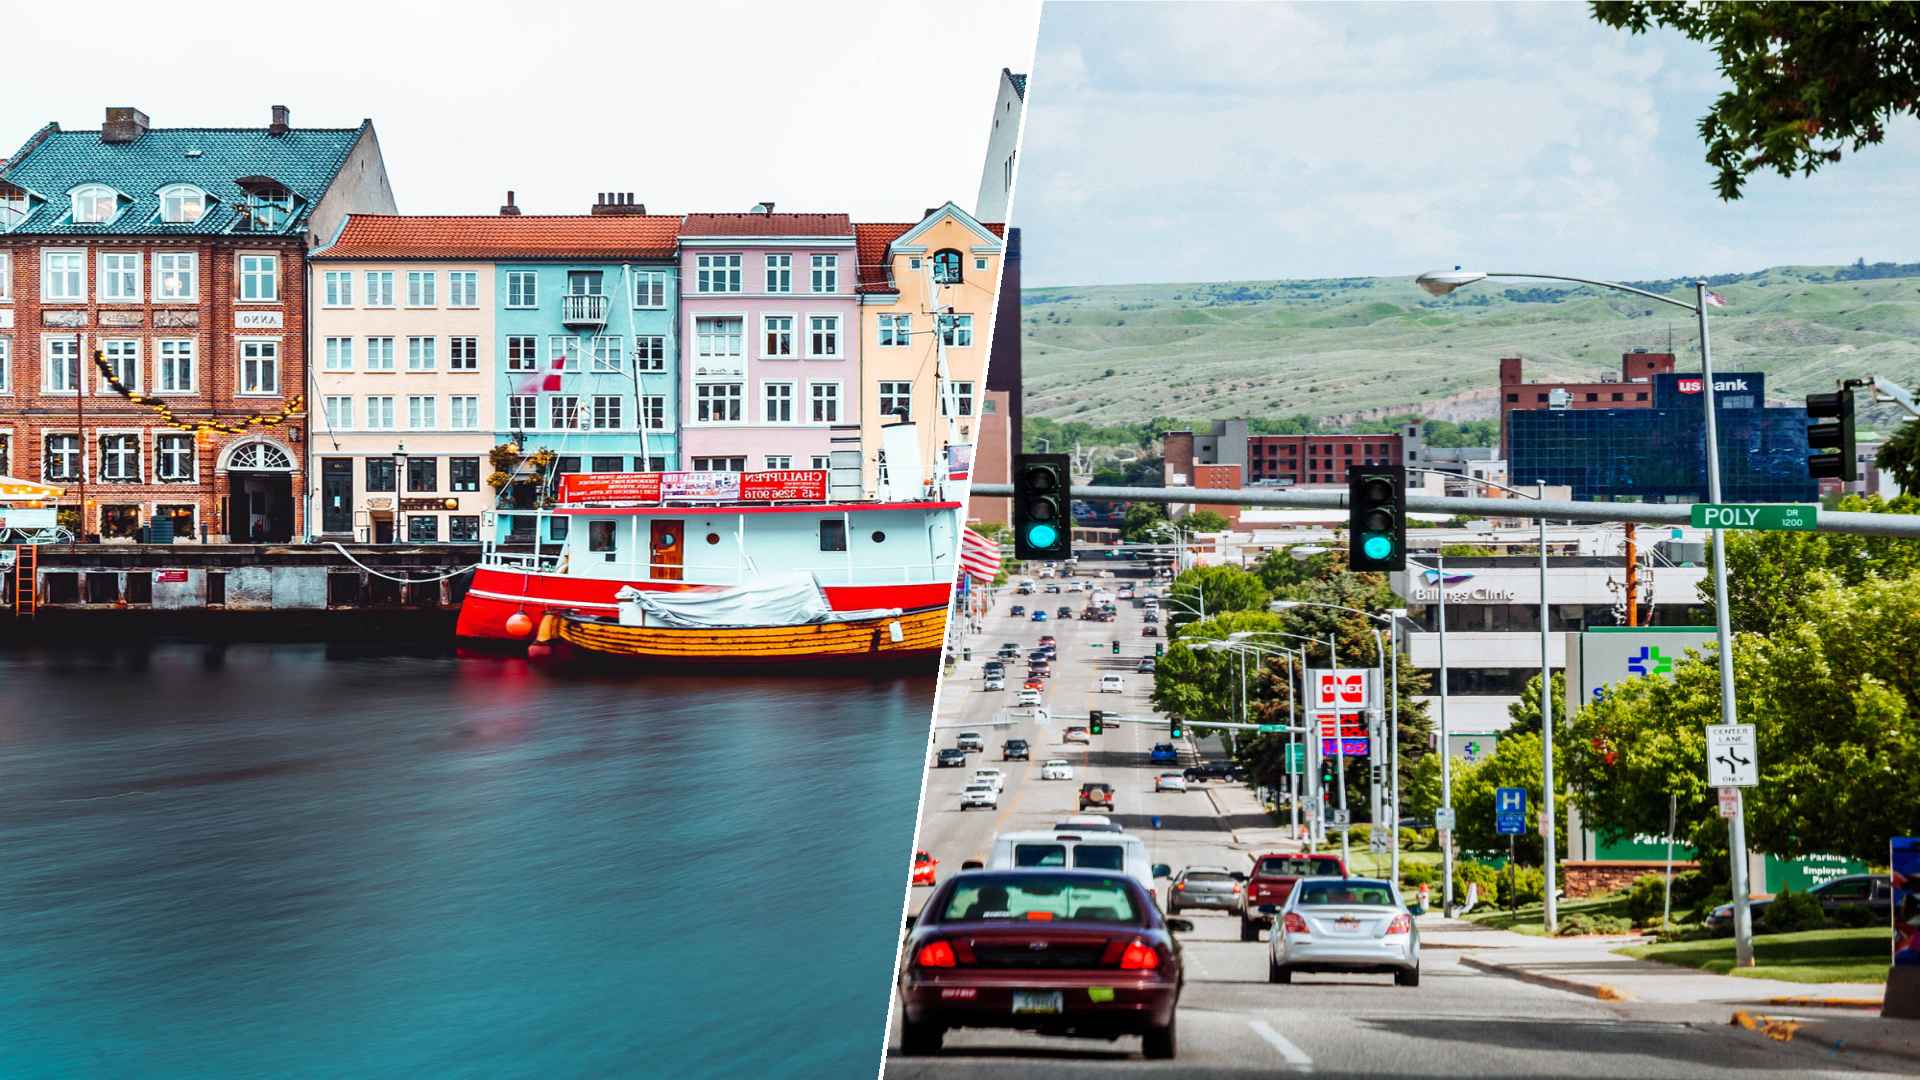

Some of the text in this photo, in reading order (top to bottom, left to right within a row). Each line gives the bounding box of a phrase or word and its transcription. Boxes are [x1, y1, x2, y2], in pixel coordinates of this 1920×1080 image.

[1679, 378, 1748, 392] us ank
[1704, 508, 1760, 526] POLY
[1782, 518, 1803, 527] 1200
[1472, 587, 1515, 601] Clinic
[1503, 792, 1520, 809] H
[1803, 866, 1847, 876] Employee
